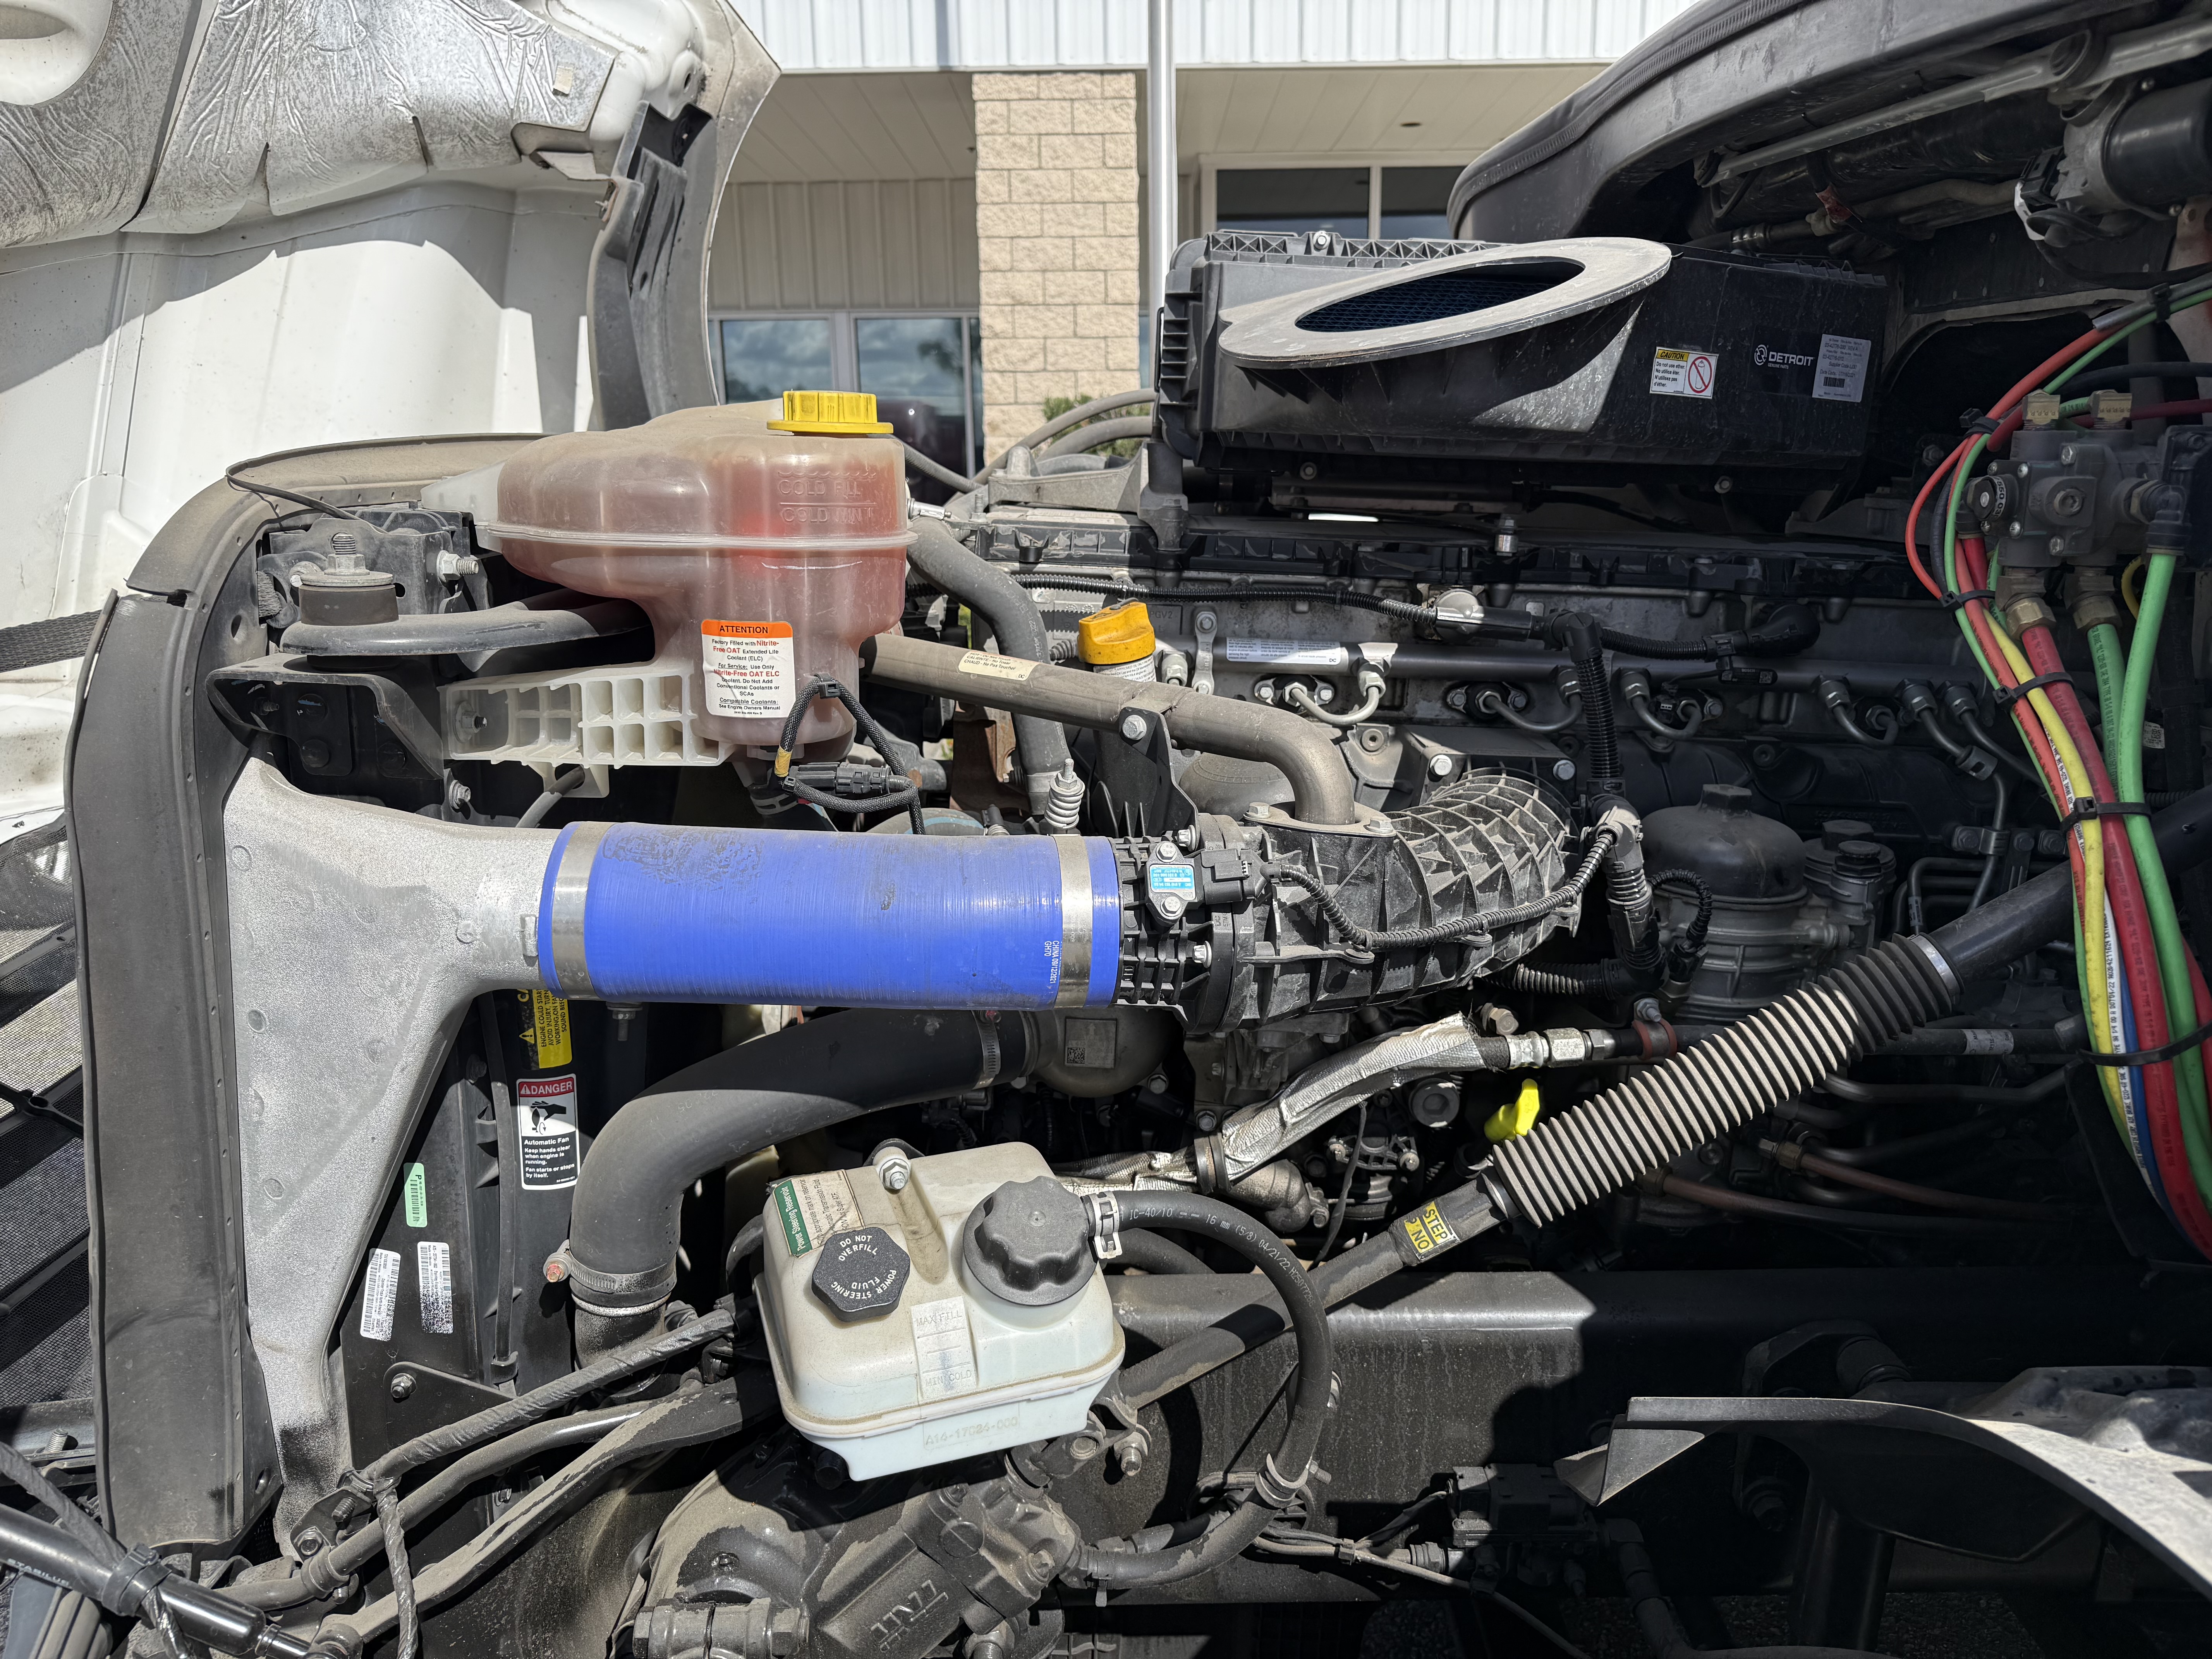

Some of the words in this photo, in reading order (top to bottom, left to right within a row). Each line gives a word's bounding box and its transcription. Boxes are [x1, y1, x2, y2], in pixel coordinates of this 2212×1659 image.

[1660, 351, 1685, 360] CAUTION
[1769, 352, 1814, 366] DETROIT
[778, 480, 826, 496] COLD
[834, 481, 861, 496] FILL
[780, 508, 828, 523] COLD
[720, 625, 768, 634] ATTENTION
[714, 668, 747, 677] Nitrite-Free
[531, 1081, 572, 1094] DANGER
[812, 1179, 822, 1188] Fluid
[781, 1187, 795, 1212] Reservoir
[805, 1201, 814, 1211] mark
[816, 1189, 830, 1214] Transmission
[836, 1200, 844, 1211] Super
[789, 1209, 802, 1235] Steering
[810, 1211, 822, 1233] appropriate
[1424, 1209, 1448, 1239] STEP
[796, 1235, 806, 1252] Power
[840, 1238, 851, 1248] DO
[1206, 1214, 1217, 1224] 16
[1221, 1220, 1231, 1230] mm
[1235, 1225, 1257, 1242] (5/8)
[1258, 1239, 1290, 1271] 04/21/22
[1411, 1229, 1430, 1250] NO
[838, 1243, 878, 1261] OVERFILL
[831, 1281, 872, 1299] STEERING
[852, 1276, 880, 1289] FLUID
[875, 1269, 897, 1294] POWER
[916, 1315, 935, 1327] MAX
[939, 1310, 962, 1322] FILL
[925, 1375, 943, 1387] MIN
[950, 1370, 972, 1382] COLD
